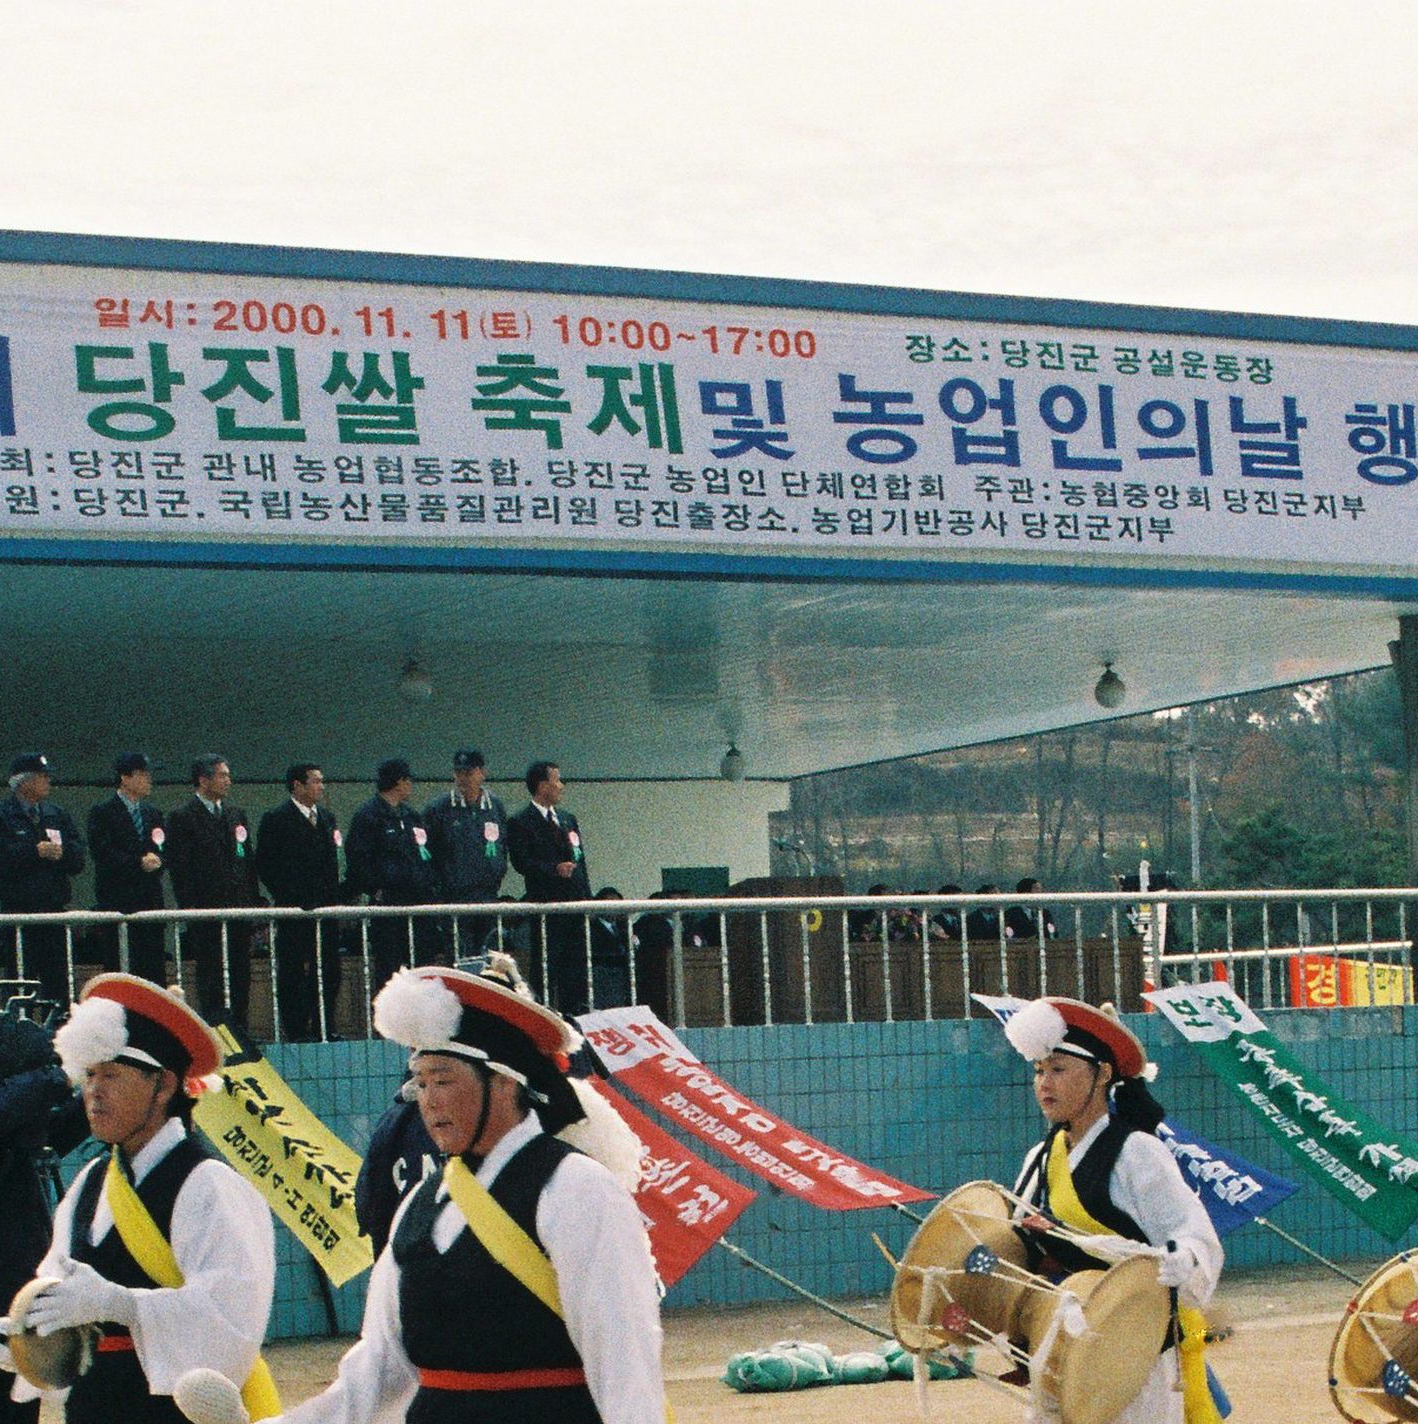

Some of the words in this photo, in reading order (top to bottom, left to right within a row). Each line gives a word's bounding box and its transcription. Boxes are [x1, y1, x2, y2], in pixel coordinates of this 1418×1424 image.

[554, 314, 817, 359] 10:00~17:00
[1113, 344, 1274, 384] 공설운동장
[75, 341, 425, 446] 당진쌀
[833, 373, 1308, 480] 농업인의날
[202, 452, 278, 483] 관내
[548, 459, 651, 491] 당진군
[665, 464, 767, 497] 농업인
[782, 469, 945, 501] 단체연합회
[1224, 487, 1366, 520] 당진군지부
[218, 489, 599, 526] 국립농산물품질관리원
[811, 506, 1008, 537] 농업기반공사
[1022, 511, 1174, 543] 당진군지부
